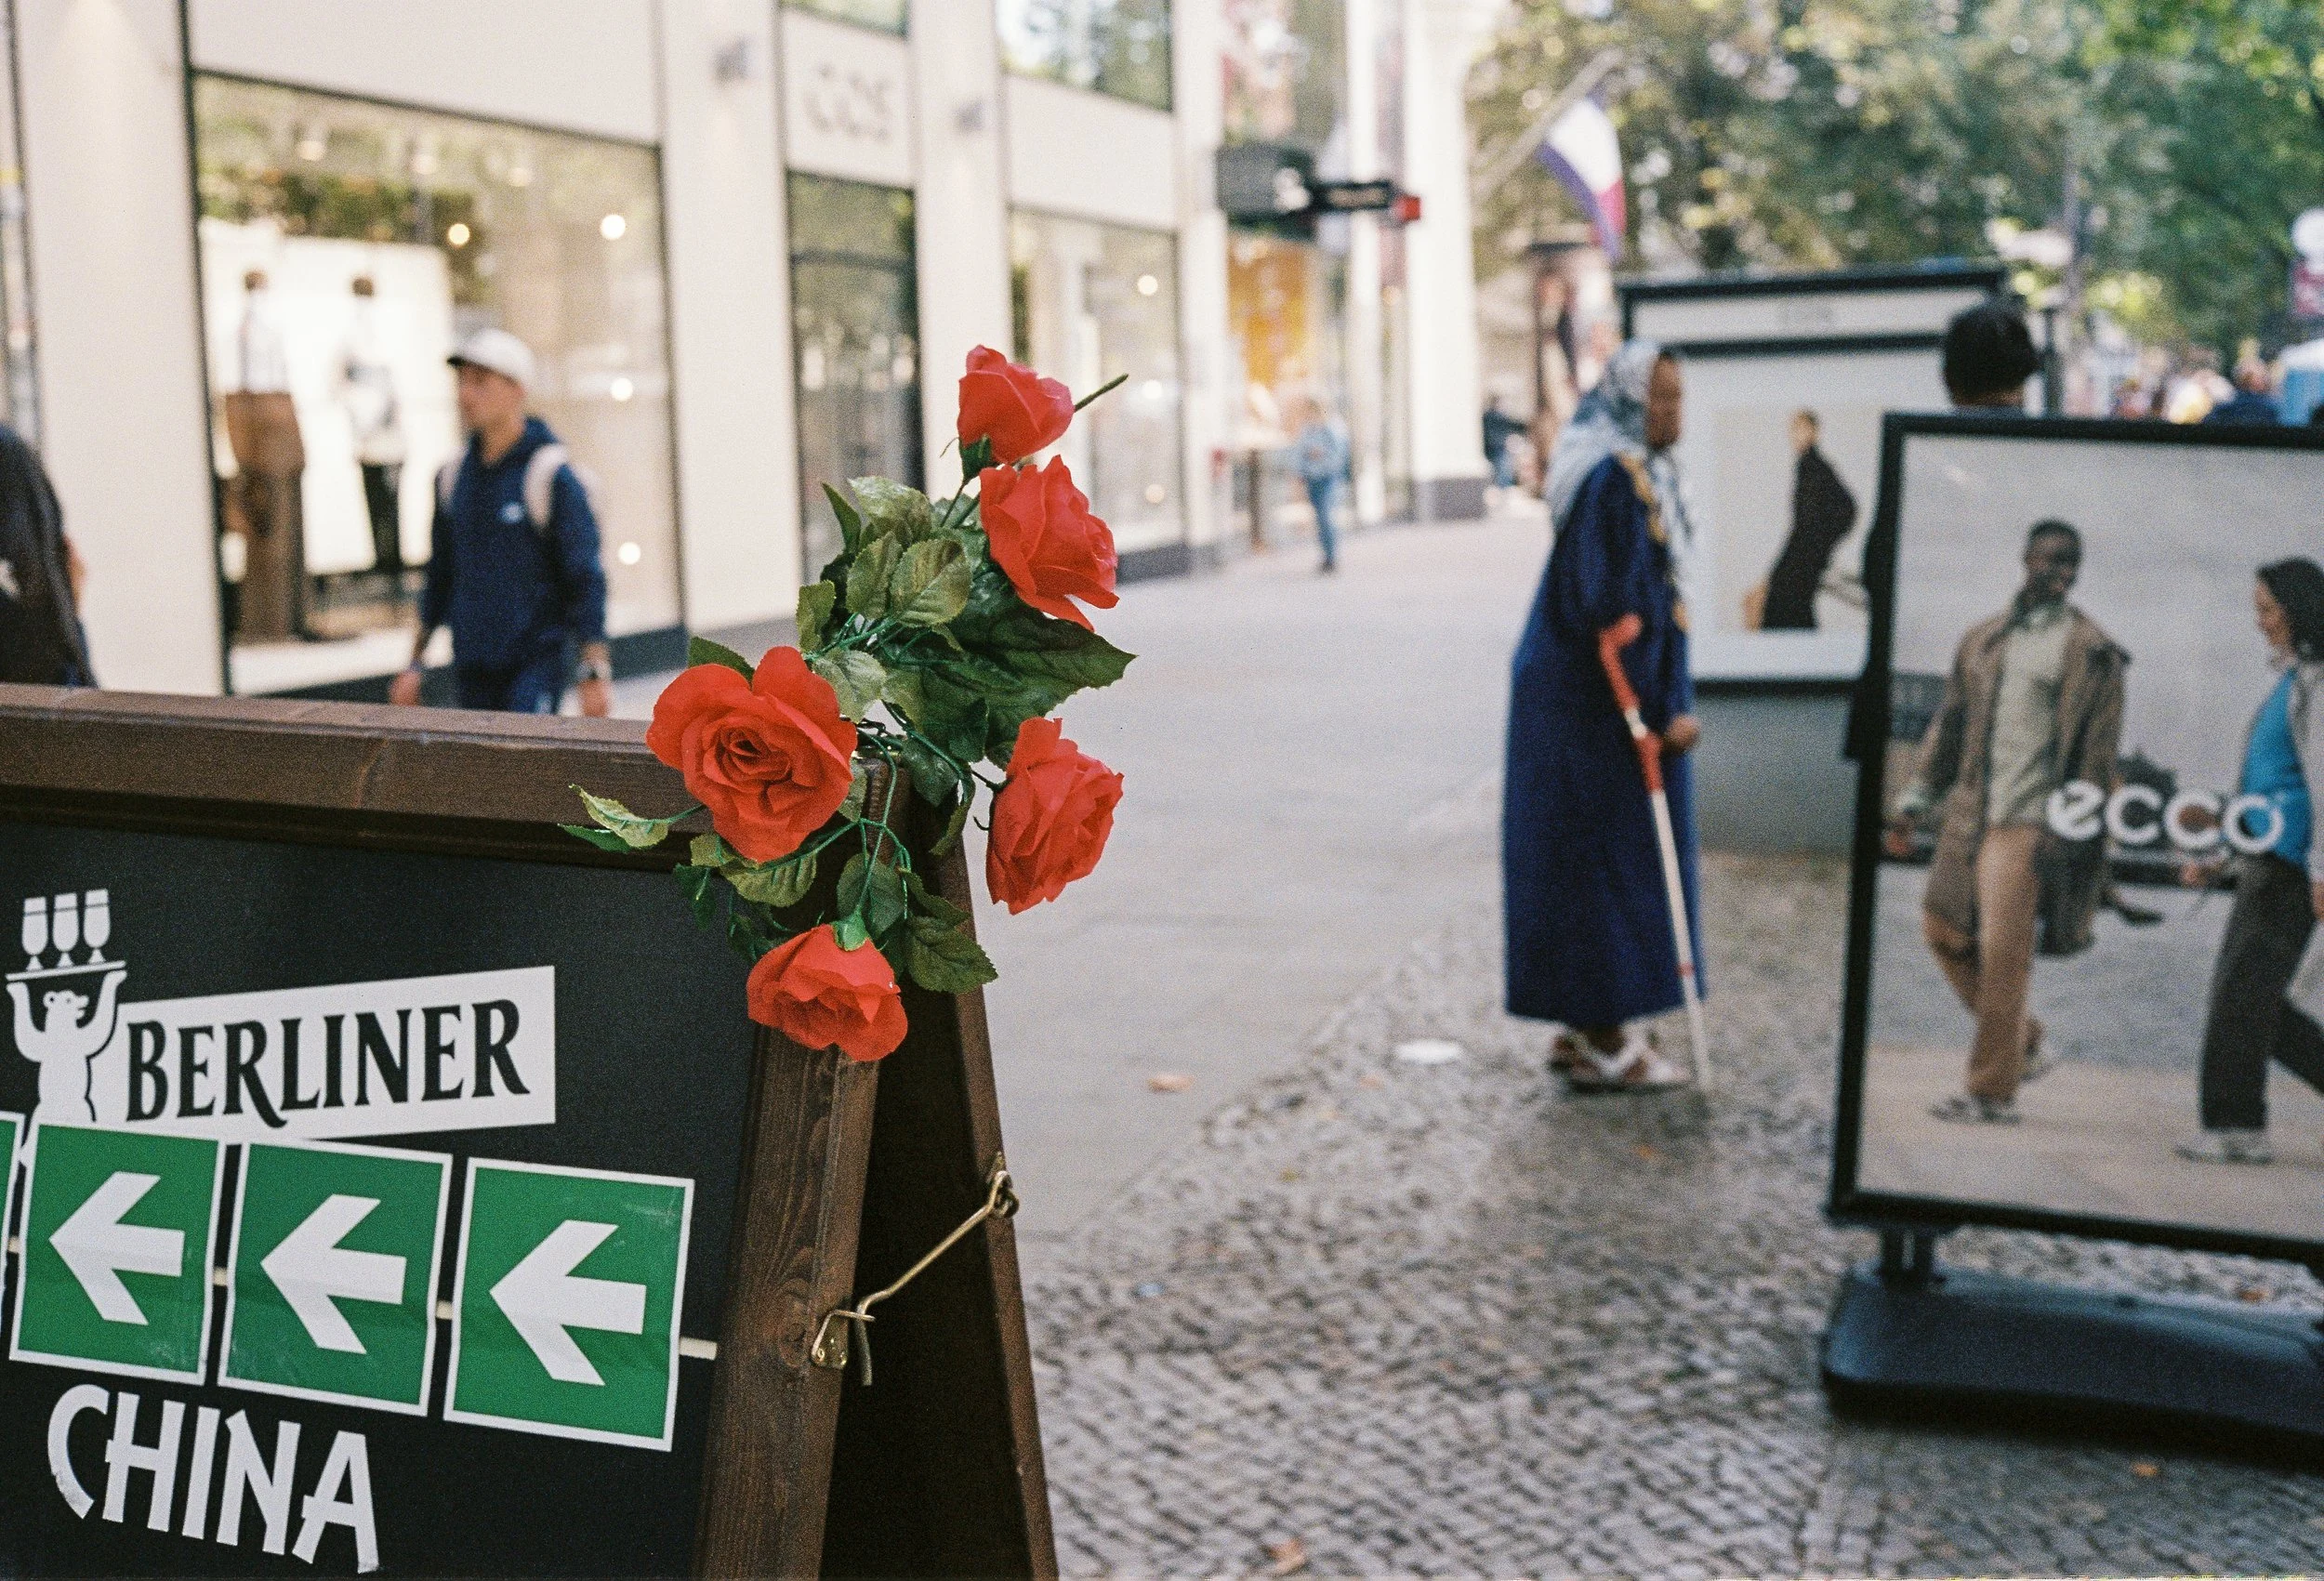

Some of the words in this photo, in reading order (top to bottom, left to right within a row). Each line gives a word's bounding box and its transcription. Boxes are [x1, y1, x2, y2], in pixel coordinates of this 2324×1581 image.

[2047, 780, 2284, 854] ecco
[125, 998, 531, 1128] BERLINER
[46, 1383, 380, 1574] CHINA
